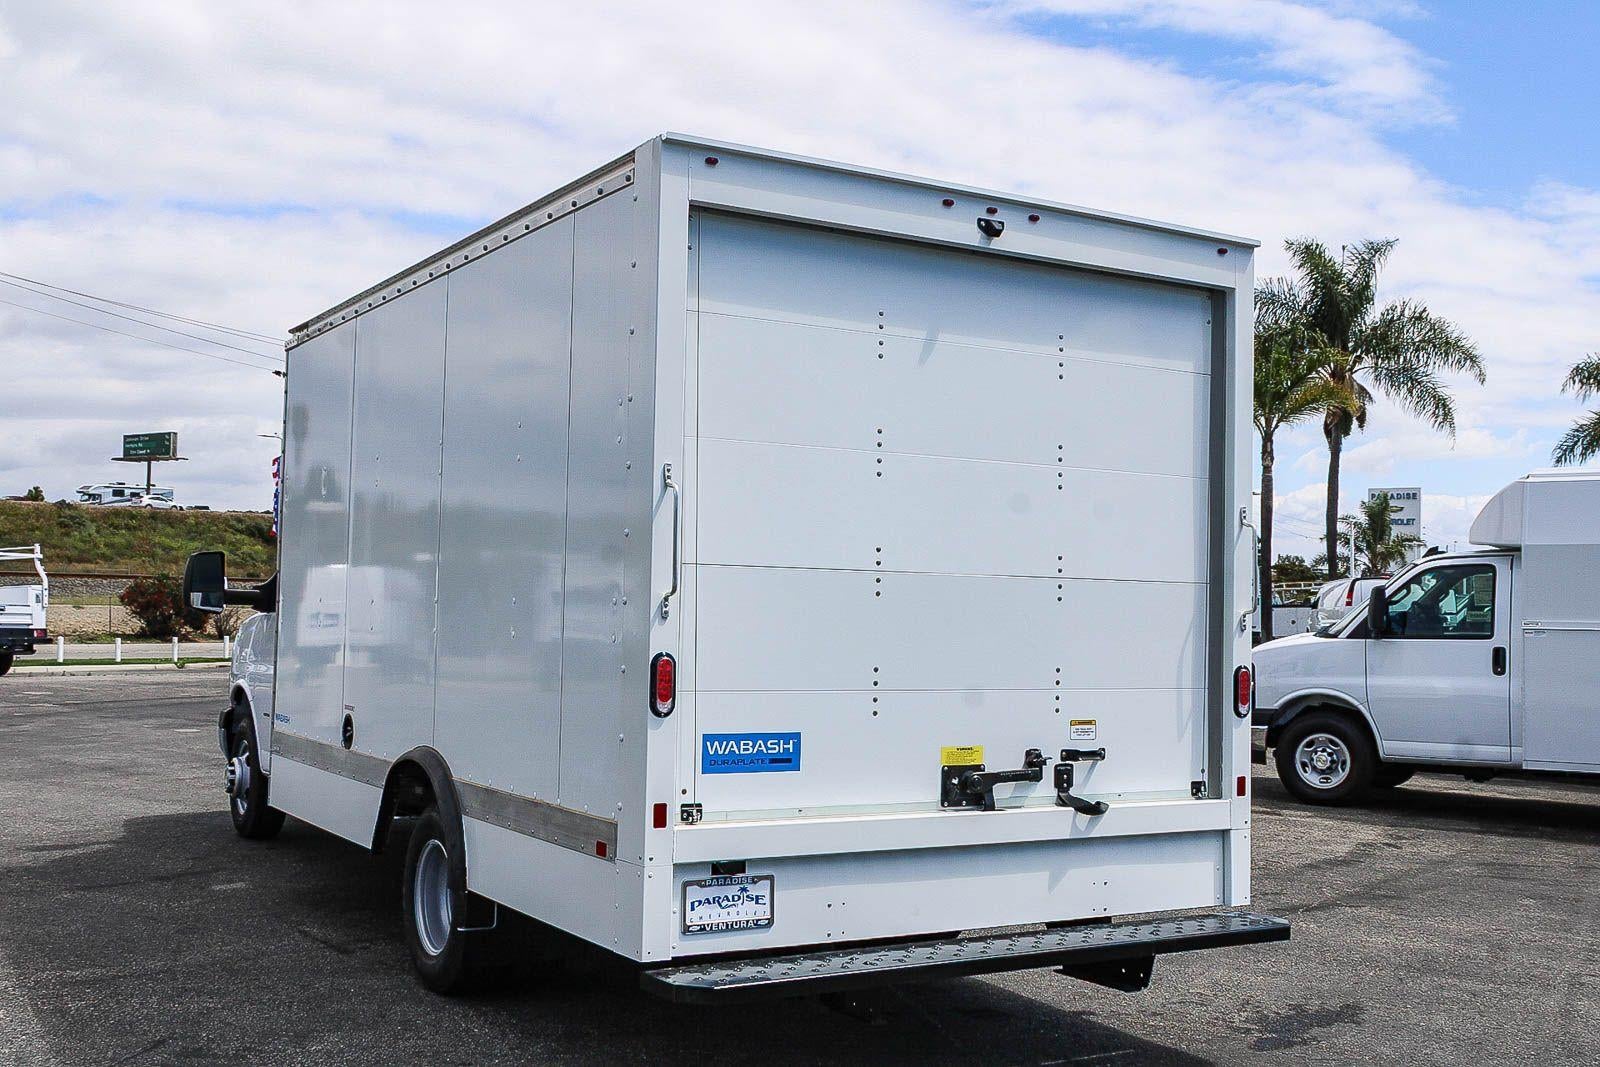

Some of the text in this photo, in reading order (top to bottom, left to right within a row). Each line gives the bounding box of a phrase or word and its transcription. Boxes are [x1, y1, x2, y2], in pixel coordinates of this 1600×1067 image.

[709, 758, 767, 767] DURAPLATE
[705, 876, 753, 886] PARADISE
[690, 889, 766, 911] PARADISE
[689, 911, 766, 923] CHEVROLET
[705, 921, 754, 931] VENTURA
